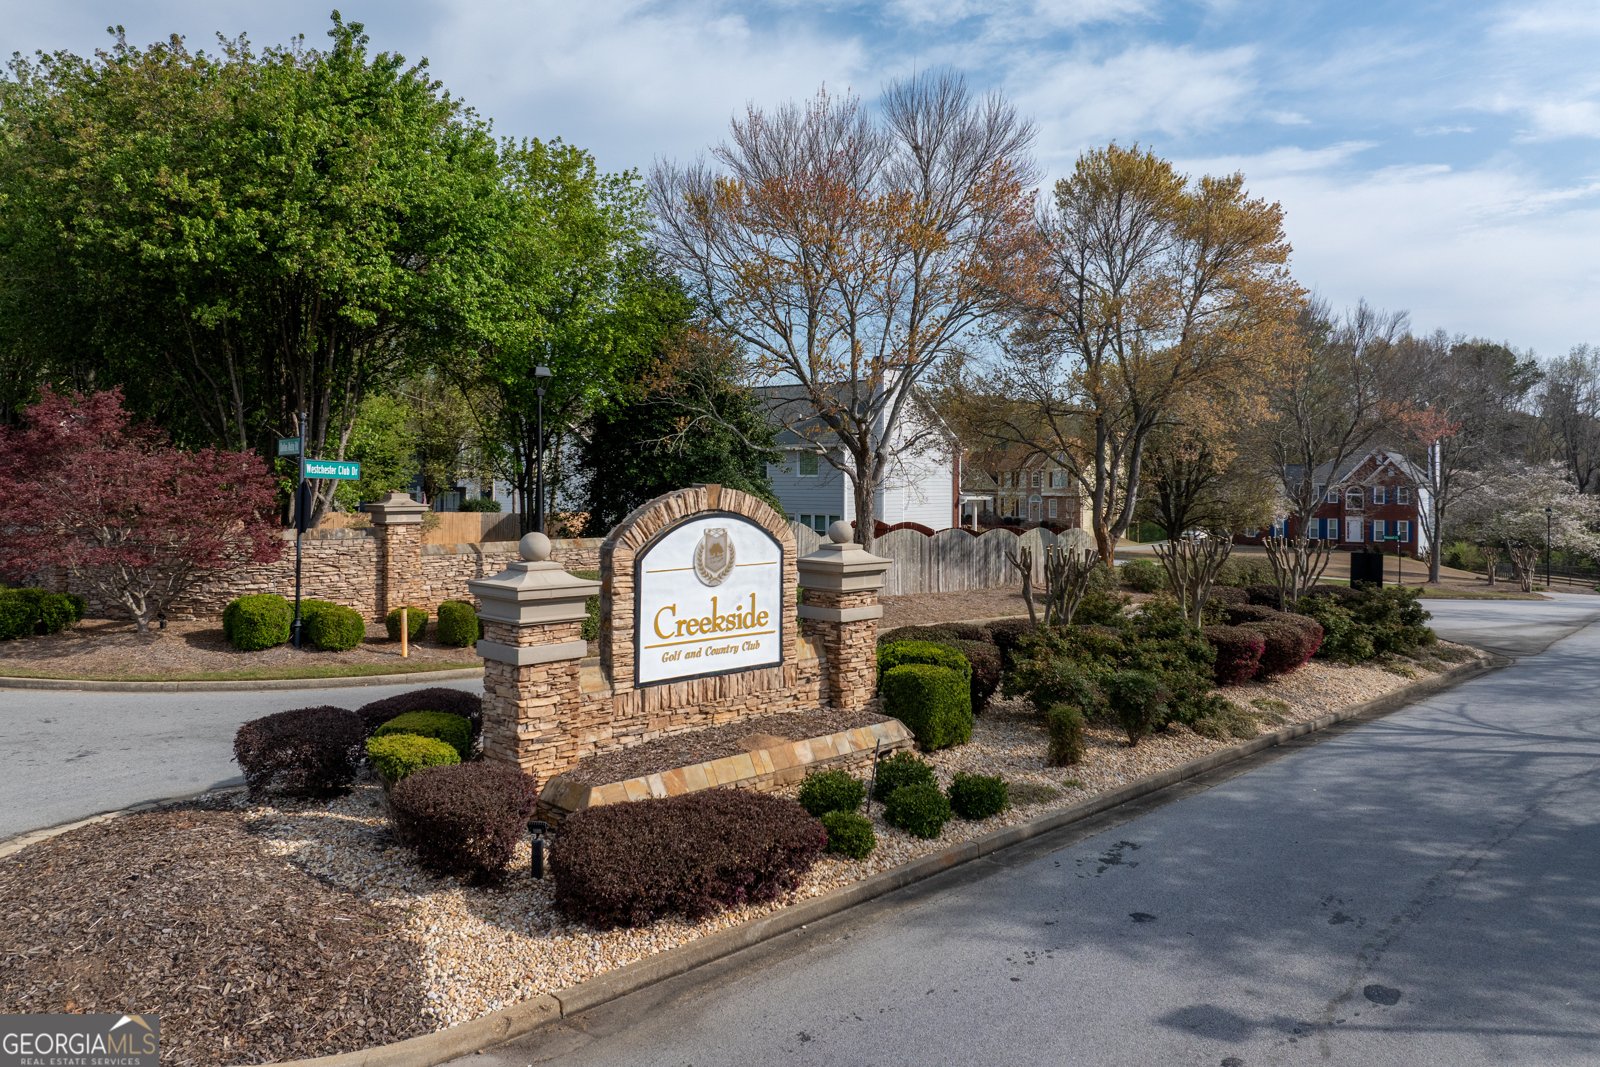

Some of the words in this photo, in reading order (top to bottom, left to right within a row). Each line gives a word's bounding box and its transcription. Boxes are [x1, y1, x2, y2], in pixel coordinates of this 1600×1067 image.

[306, 463, 337, 475] Westchester
[338, 465, 350, 476] Club
[351, 466, 358, 476] Dr
[653, 592, 769, 639] Creekside
[661, 649, 682, 663] Golf
[684, 647, 702, 660] and
[705, 644, 739, 656] Country
[742, 639, 760, 652] Club
